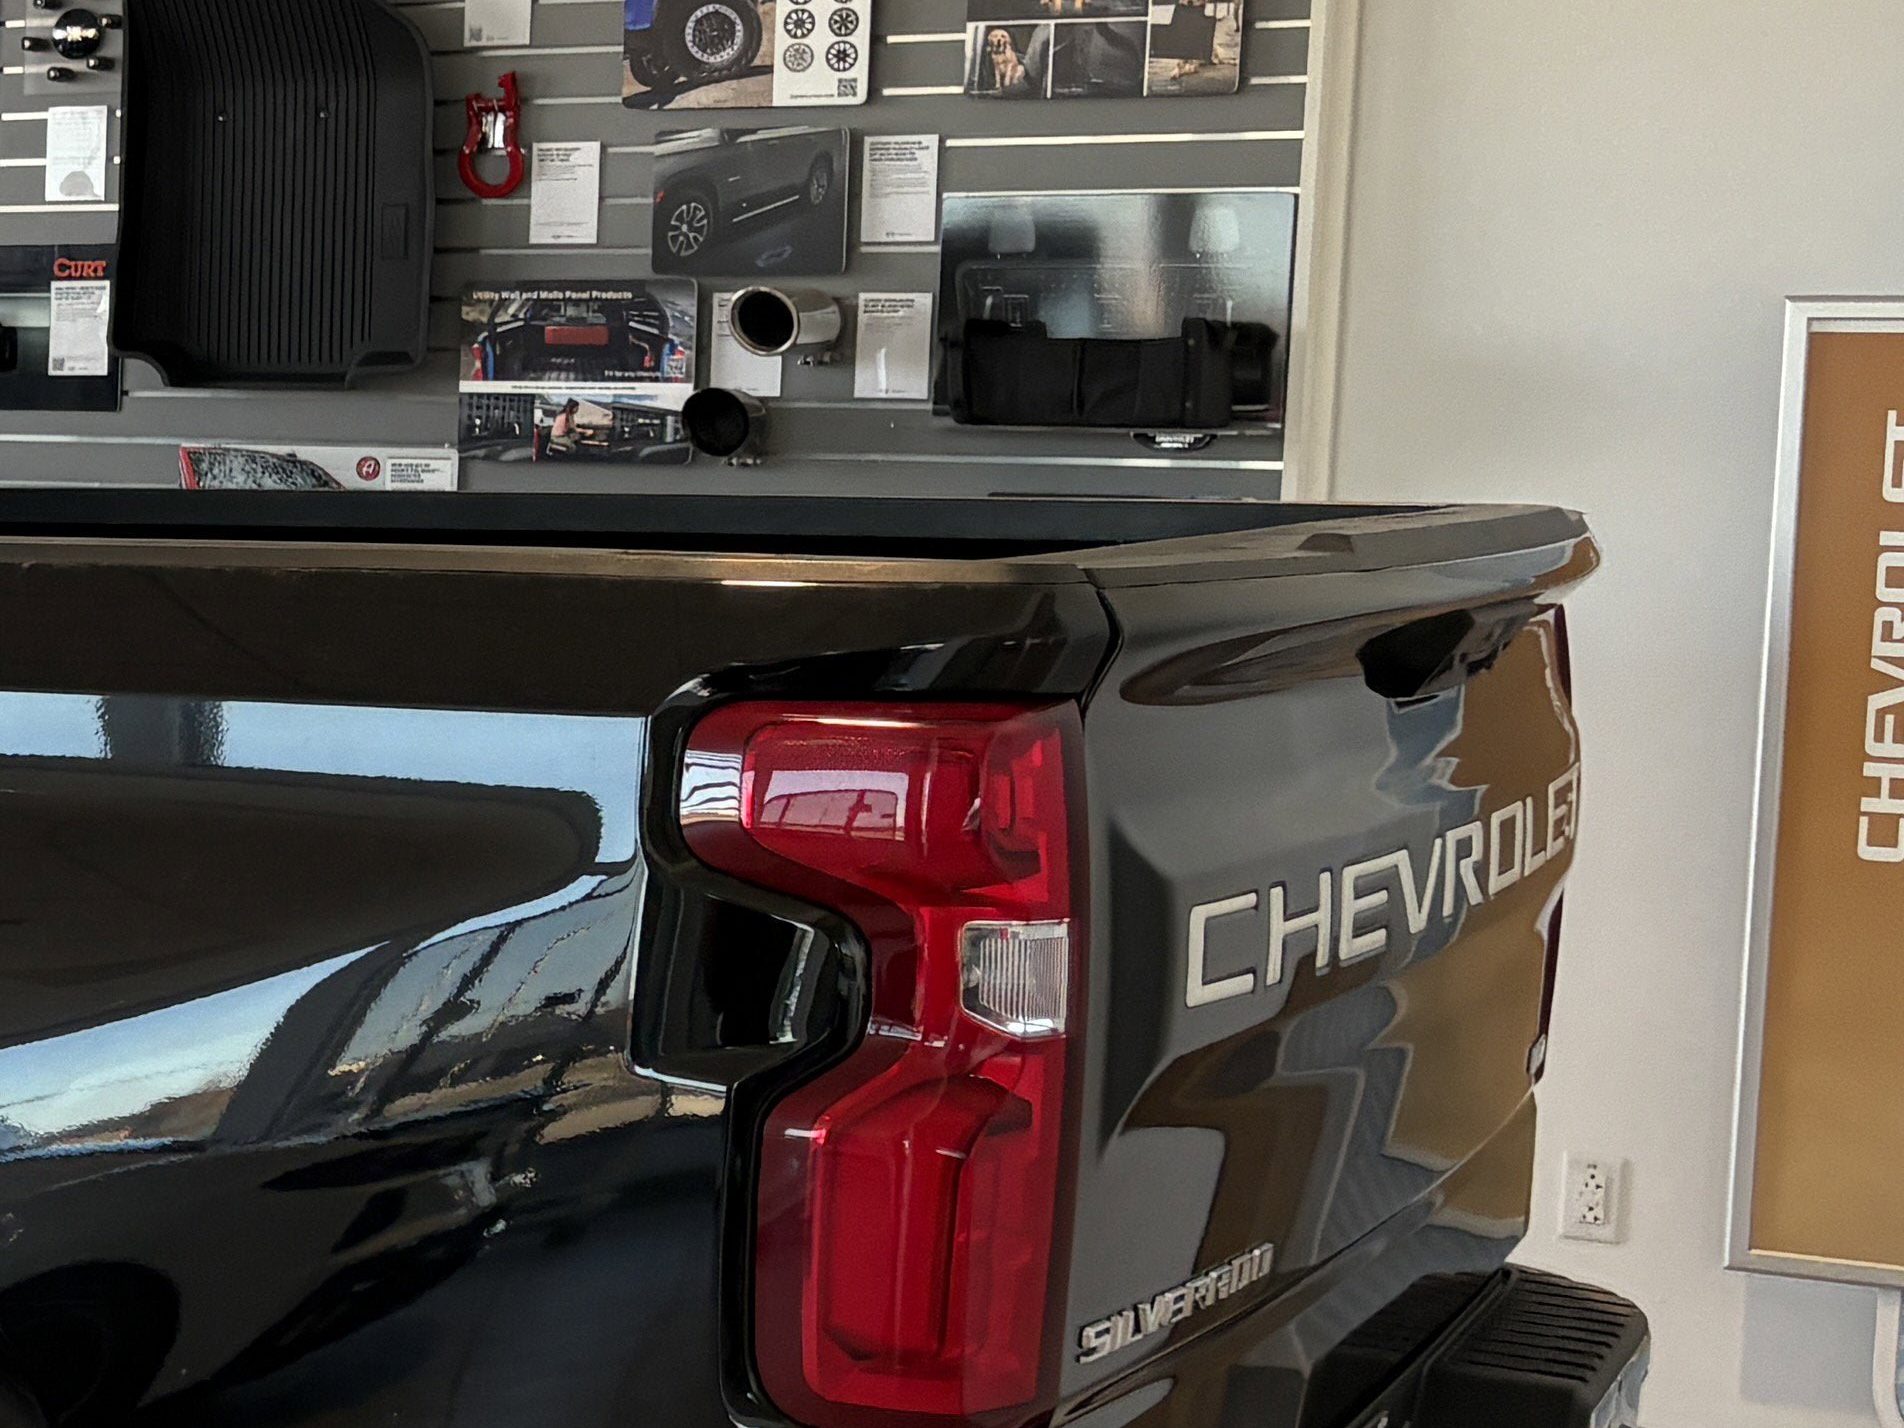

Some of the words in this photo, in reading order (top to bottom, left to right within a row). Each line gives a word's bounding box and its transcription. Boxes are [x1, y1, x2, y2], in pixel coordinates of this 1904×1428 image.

[53, 257, 107, 279] CURT
[591, 290, 633, 300] Products
[1185, 761, 1581, 1009] CHEVROLET
[1078, 1242, 1275, 1365] SILVERADO
